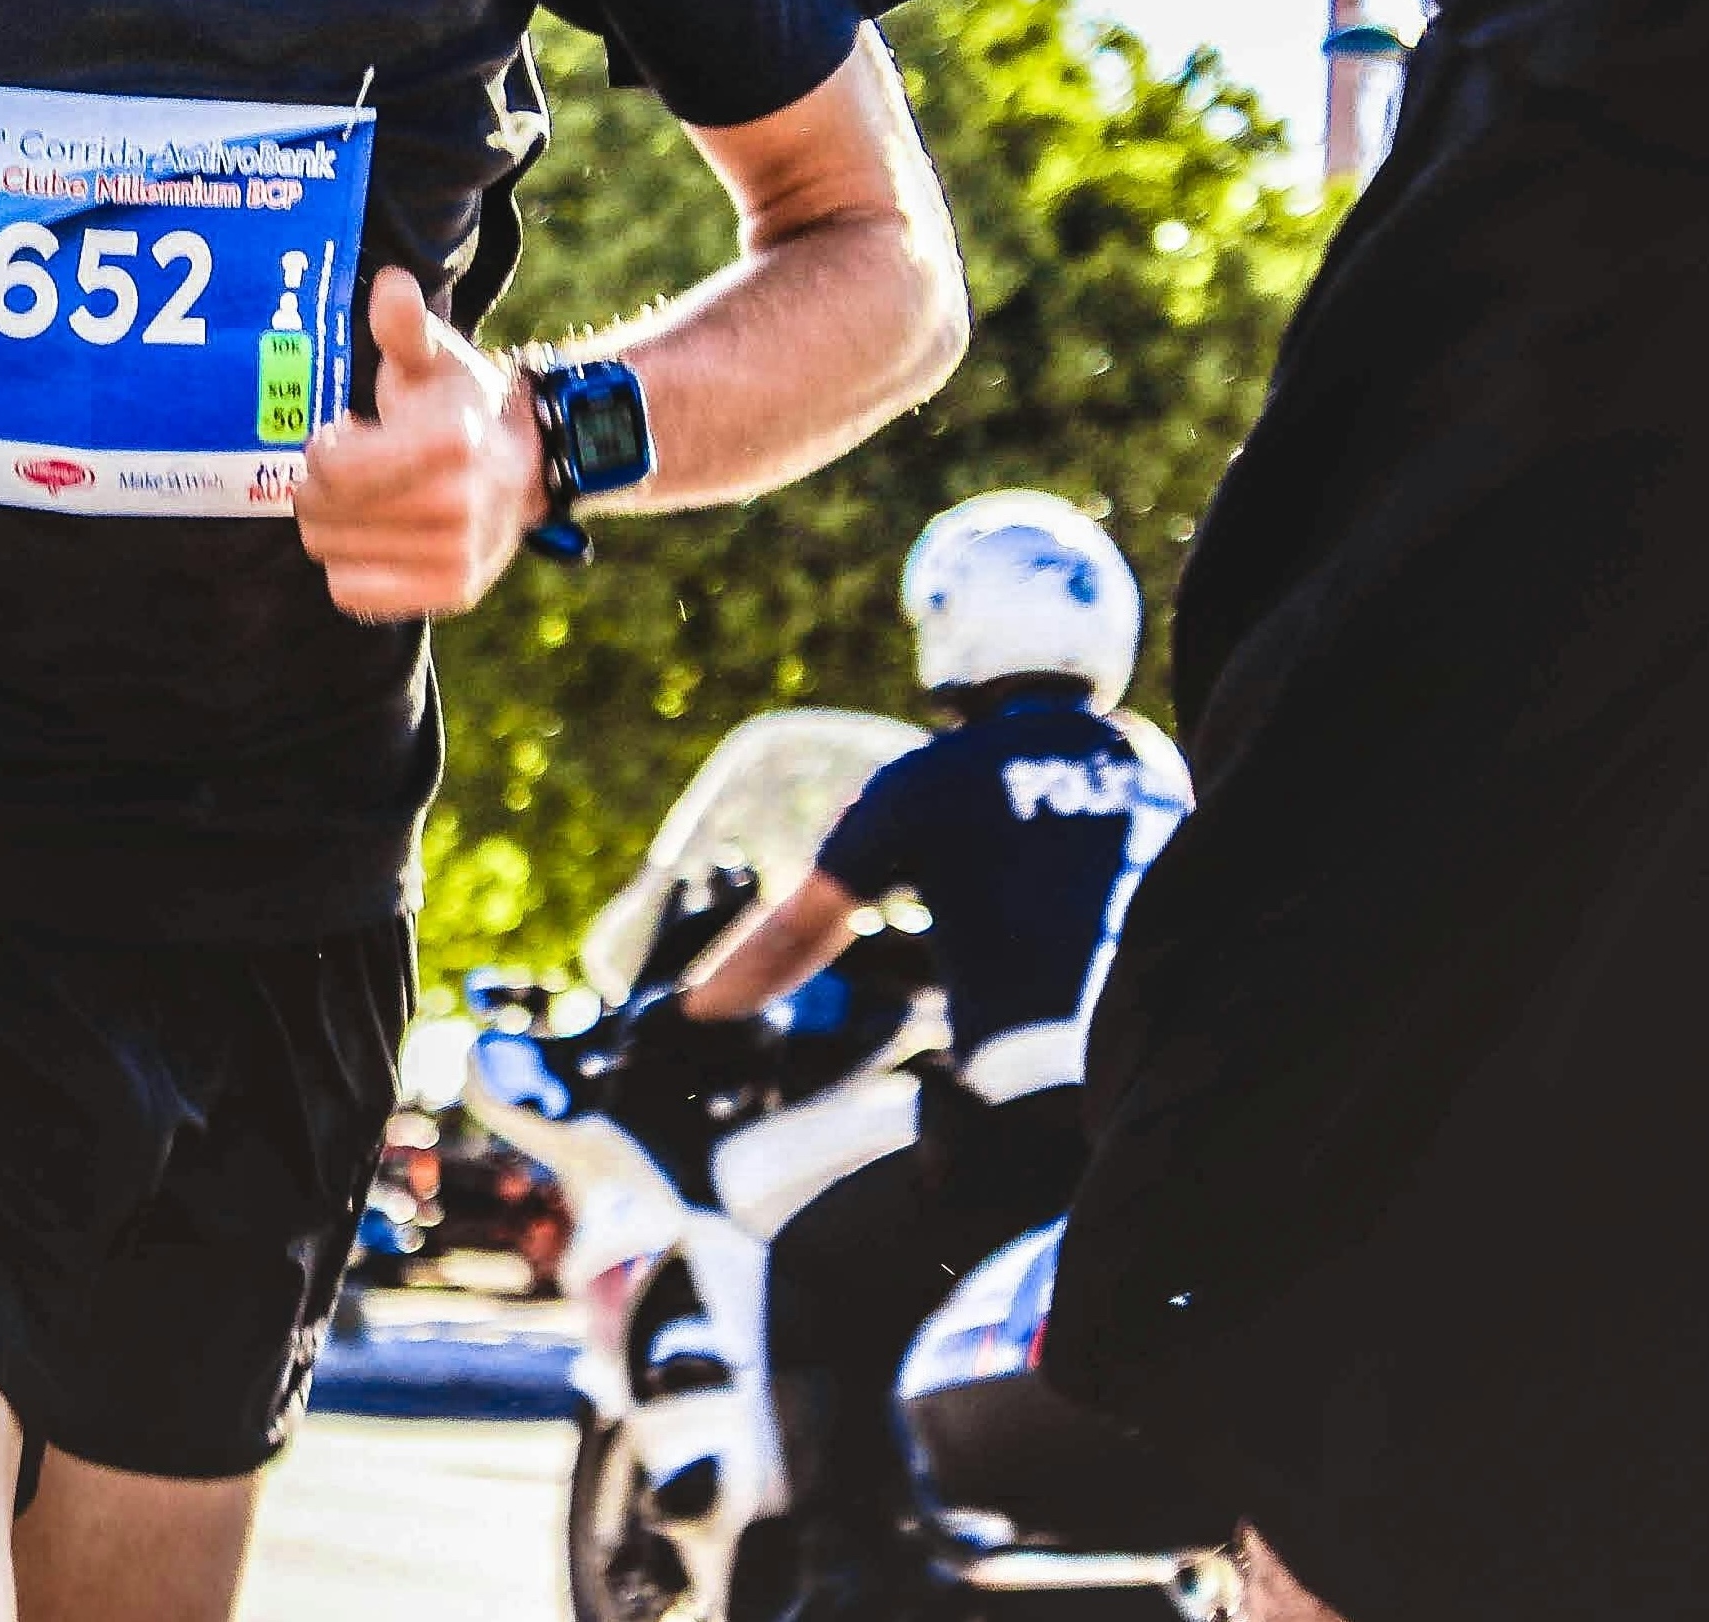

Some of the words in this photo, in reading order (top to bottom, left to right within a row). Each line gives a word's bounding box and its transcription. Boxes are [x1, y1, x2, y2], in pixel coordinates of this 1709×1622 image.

[19, 128, 147, 168] Corrida
[152, 139, 337, 179] ActivoBank
[2, 165, 88, 200] Clube
[95, 171, 242, 208] Millennium
[246, 178, 303, 210] BCP
[272, 406, 304, 433] 50
